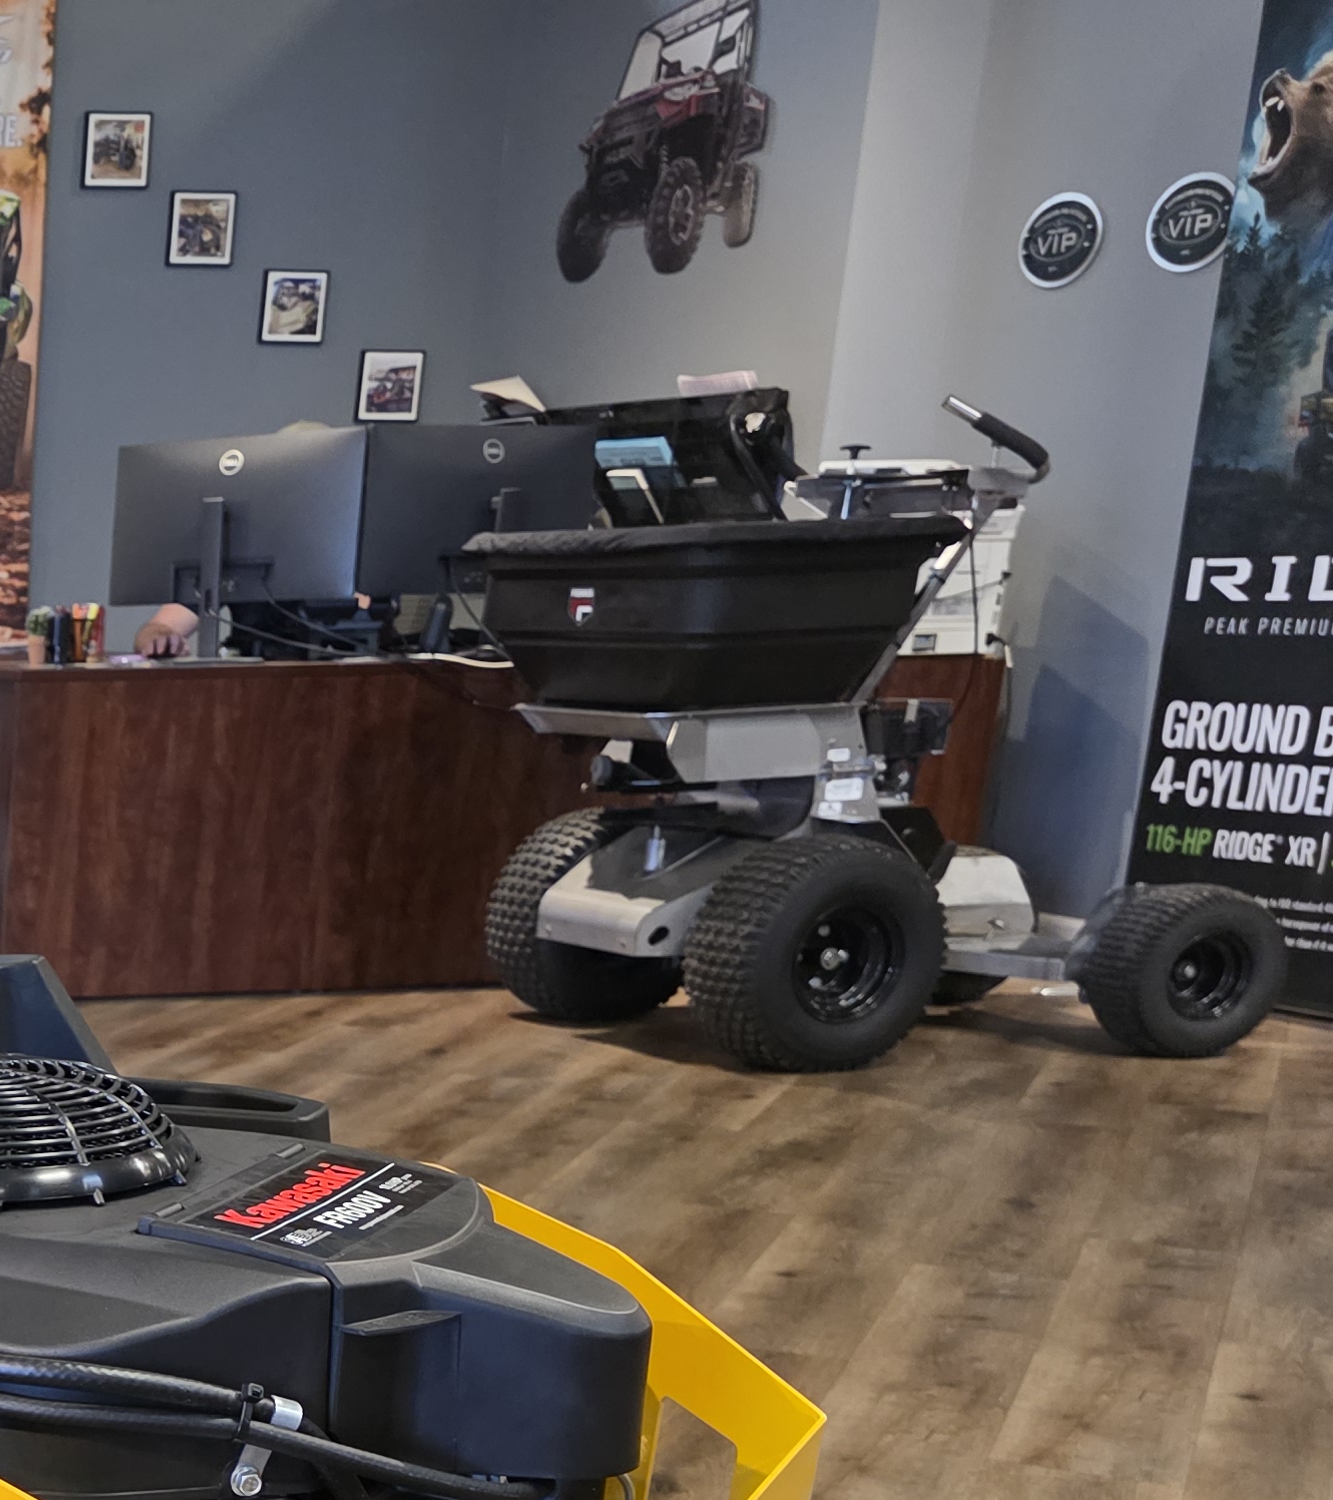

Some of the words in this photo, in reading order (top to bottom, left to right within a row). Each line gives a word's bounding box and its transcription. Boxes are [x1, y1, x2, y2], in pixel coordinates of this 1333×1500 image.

[1037, 231, 1077, 256] VIP
[1168, 213, 1214, 239] VIP
[1203, 616, 1250, 635] PEAK
[1161, 700, 1311, 756] GROUND
[1146, 824, 1214, 856] 116-HP
[1284, 836, 1318, 868] XR
[214, 1162, 366, 1229] Kawasaki
[312, 1190, 392, 1229] FR600V
